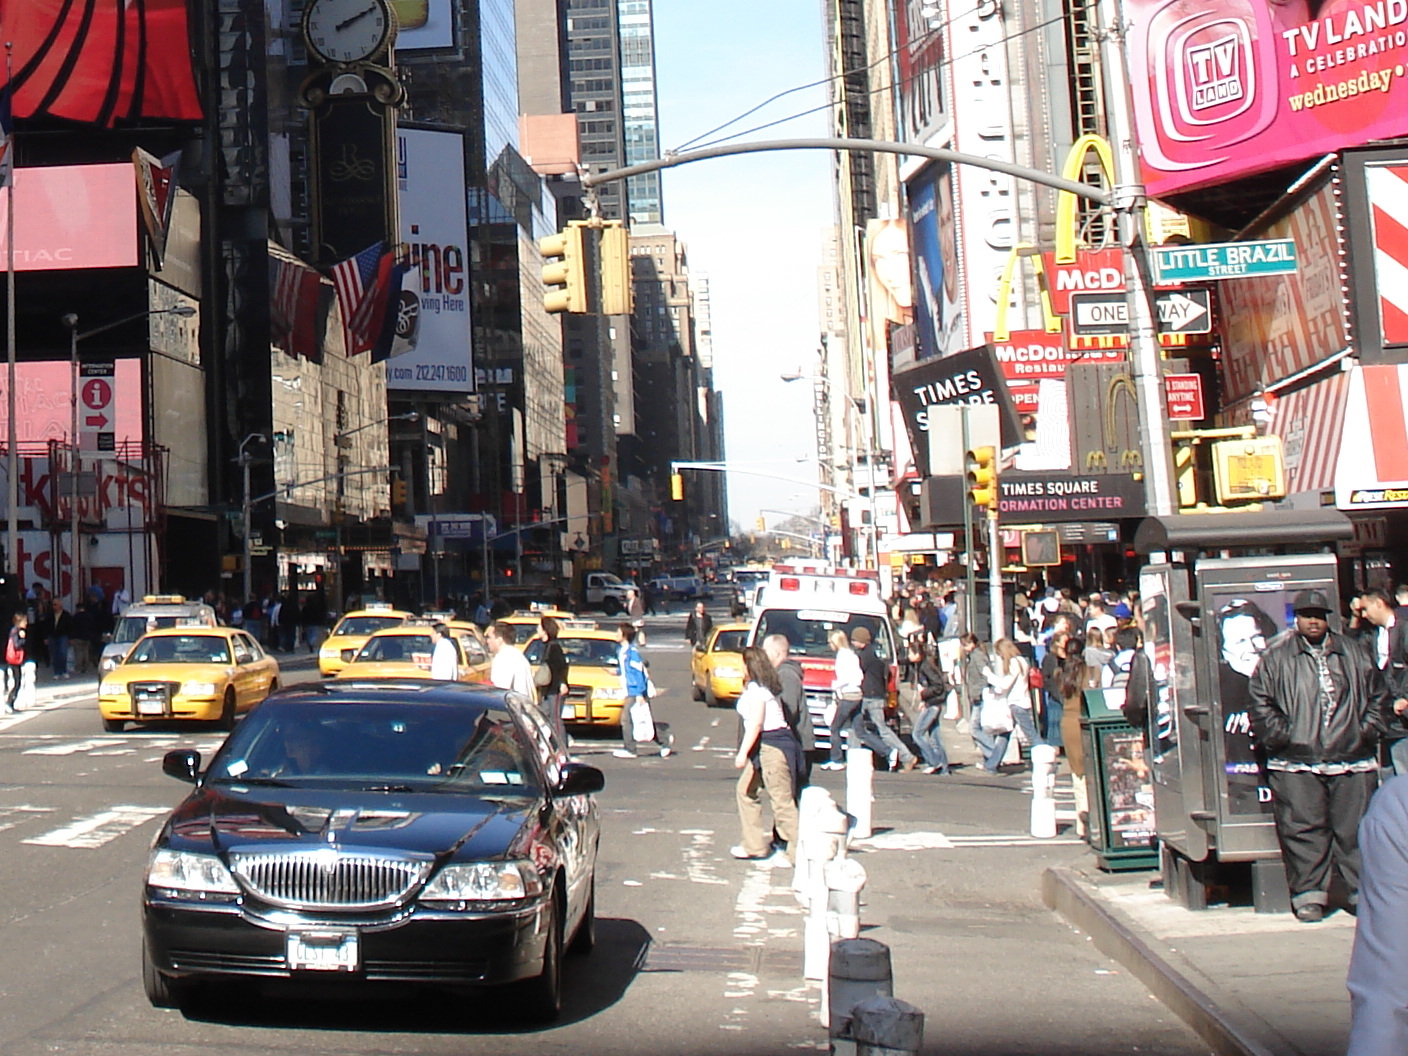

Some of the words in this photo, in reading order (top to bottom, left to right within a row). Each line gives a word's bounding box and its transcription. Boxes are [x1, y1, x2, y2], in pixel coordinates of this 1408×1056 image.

[1283, 23, 1321, 57] TV
[1288, 66, 1393, 112] wednesday
[1158, 248, 1219, 270] LITTLE
[1226, 243, 1295, 264] BRAZIL
[1208, 263, 1247, 275] STREET
[443, 294, 465, 312] Here
[1091, 305, 1128, 322] ONE
[913, 370, 983, 407] TIMES
[1002, 482, 1044, 496] TIMES
[1046, 480, 1099, 496] SQUARE
[1071, 496, 1123, 510] CENTER
